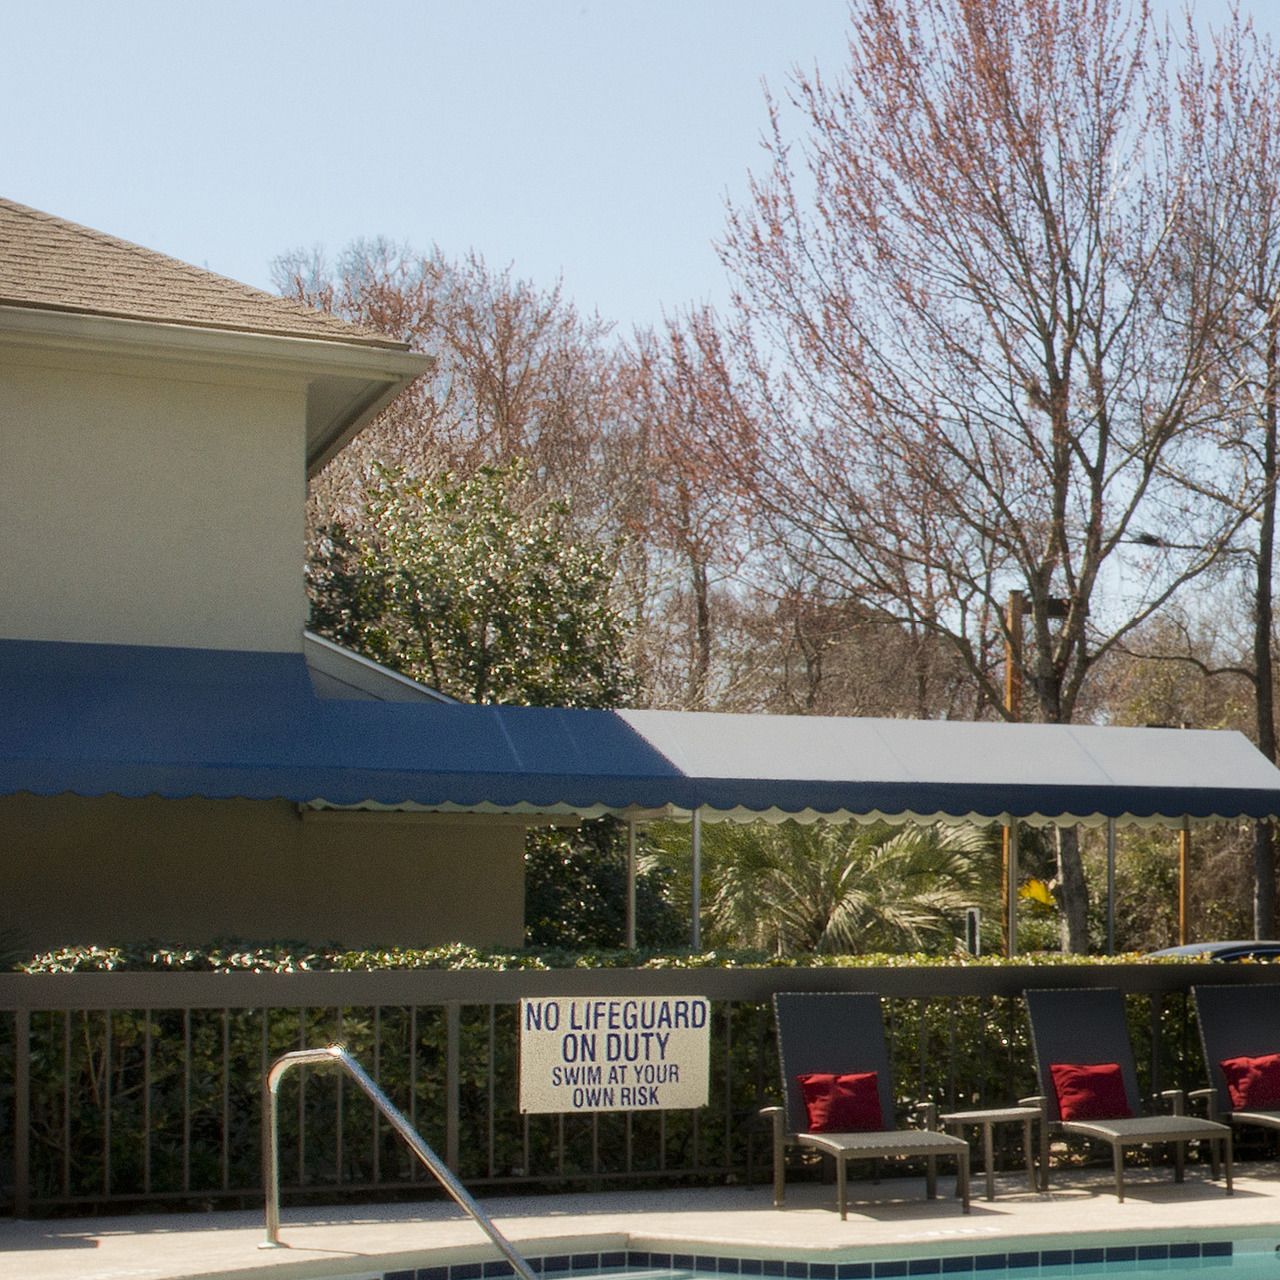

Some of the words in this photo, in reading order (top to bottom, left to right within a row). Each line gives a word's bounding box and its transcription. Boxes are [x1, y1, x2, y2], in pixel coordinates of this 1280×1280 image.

[526, 1001, 560, 1031] NO
[570, 1000, 707, 1030] LIFEGUARD
[562, 1033, 596, 1063] ON
[607, 1032, 670, 1062] DUTY
[552, 1065, 601, 1087] SWIM
[608, 1065, 627, 1085] AT
[634, 1064, 679, 1084] YOUR
[573, 1087, 614, 1108] OWN
[620, 1086, 660, 1106] RISK
